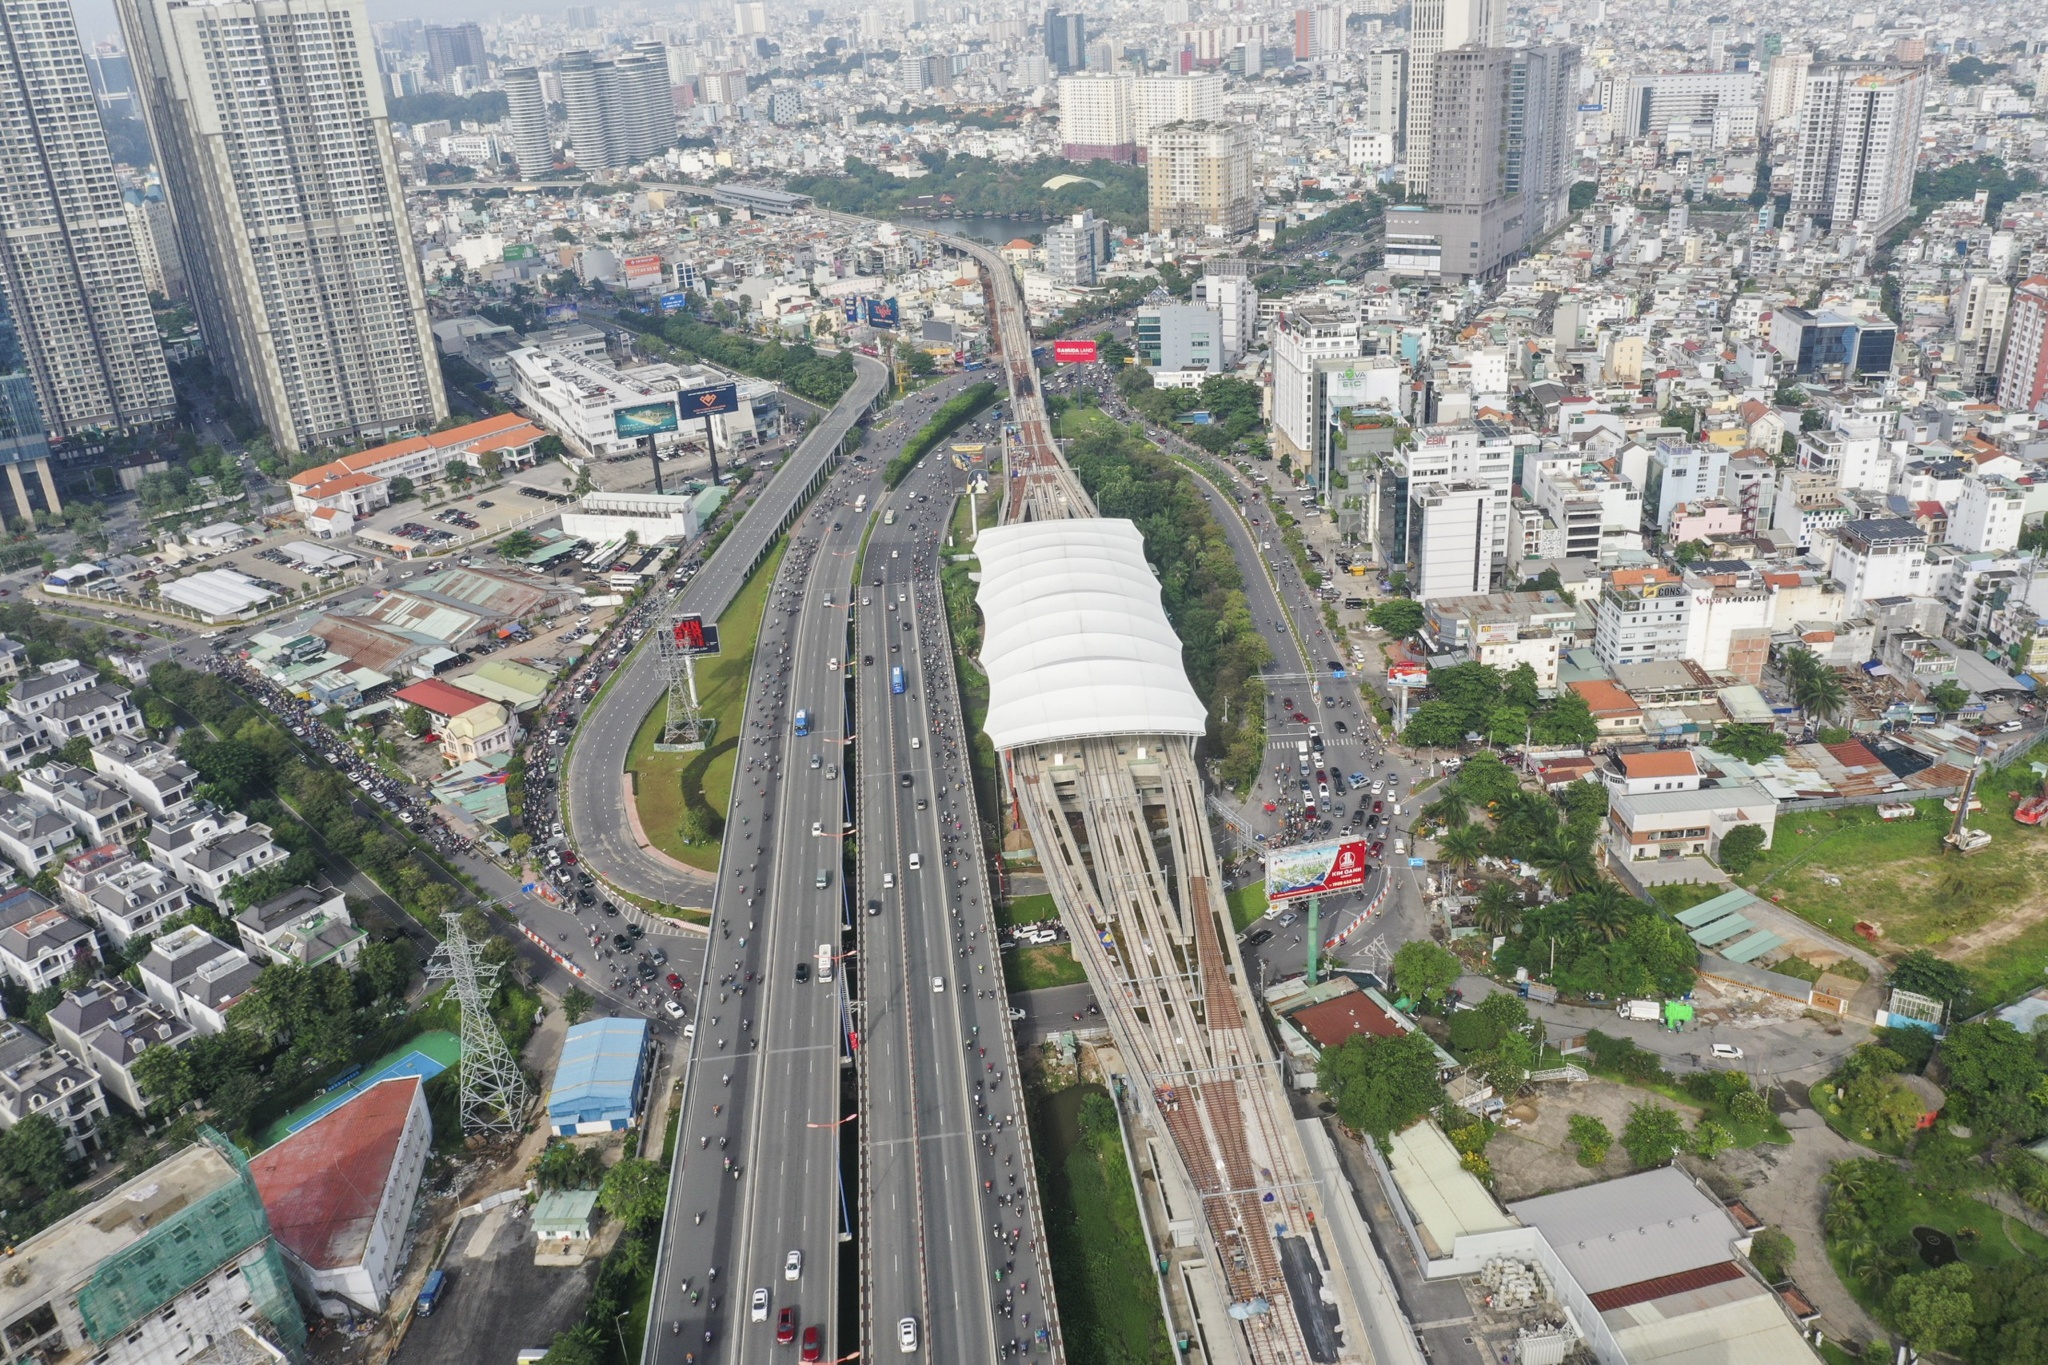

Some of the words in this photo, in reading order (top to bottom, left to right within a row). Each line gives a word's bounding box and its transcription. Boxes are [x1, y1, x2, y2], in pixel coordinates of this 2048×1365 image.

[1426, 435, 1446, 446] EBM
[1658, 587, 1681, 597] CONS
[1344, 866, 1362, 875] OANH
